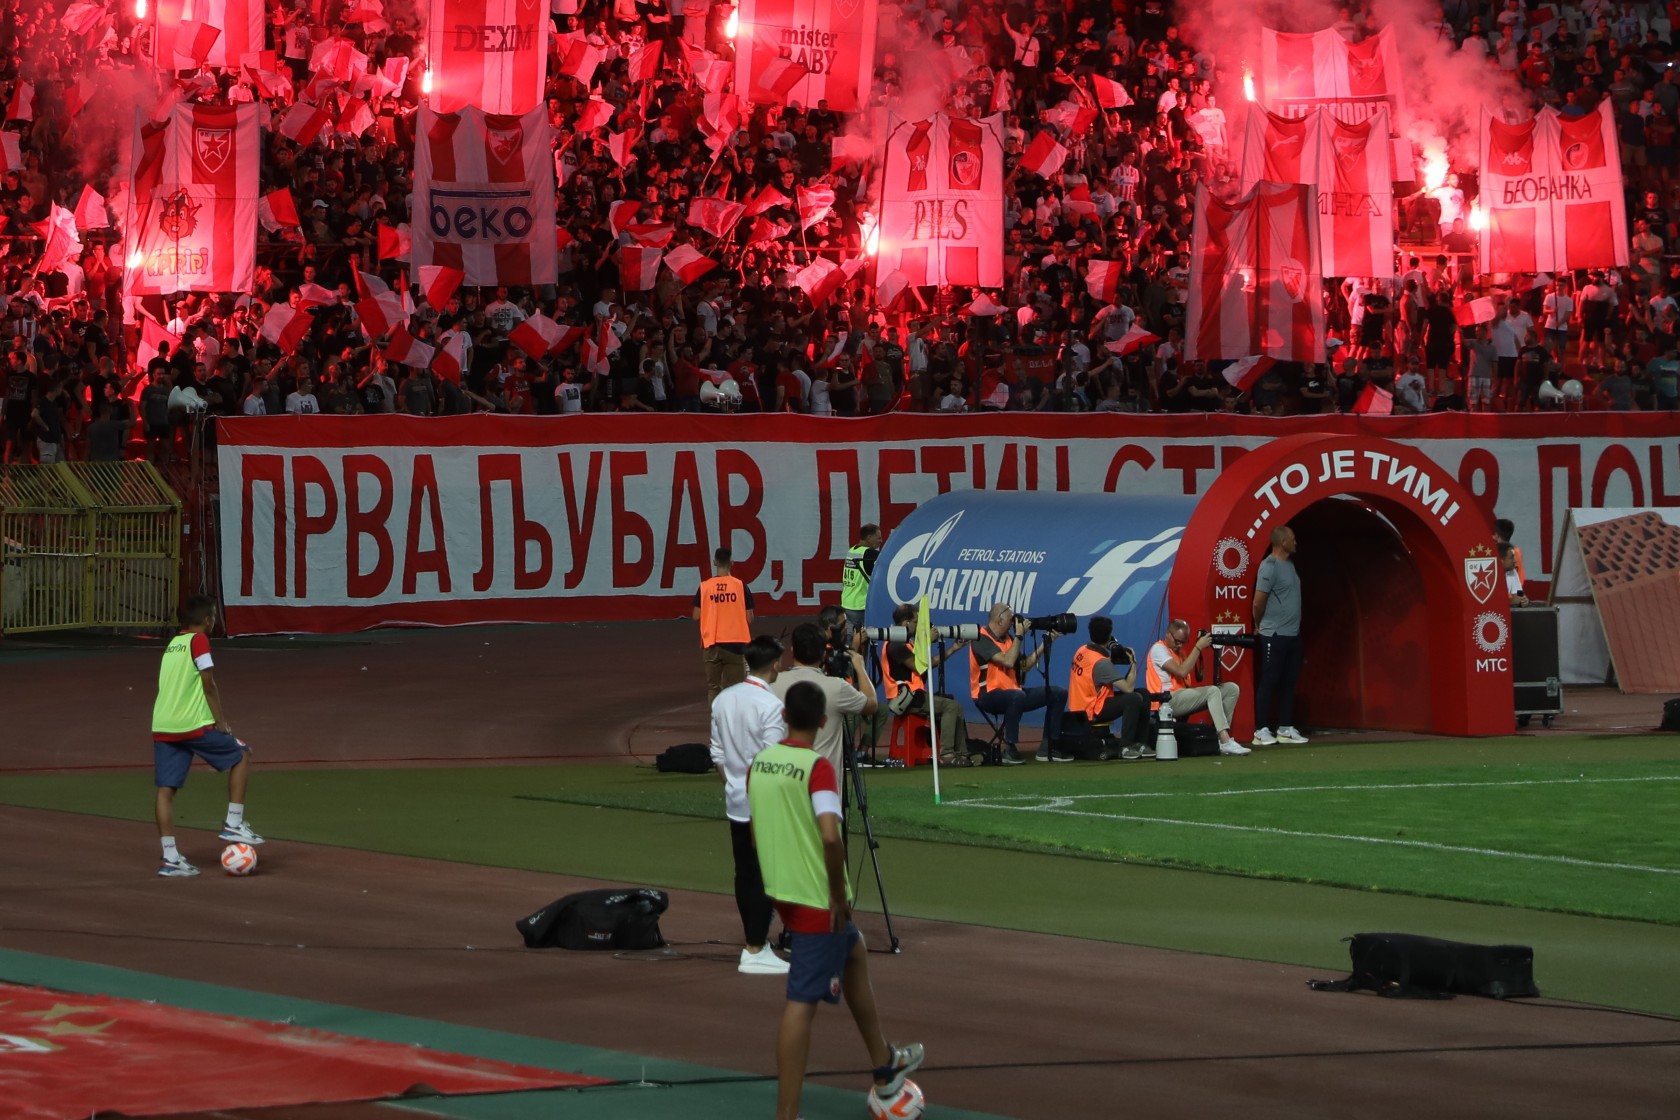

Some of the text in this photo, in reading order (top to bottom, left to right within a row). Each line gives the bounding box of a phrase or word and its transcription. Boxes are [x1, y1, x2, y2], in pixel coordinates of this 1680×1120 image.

[453, 24, 533, 53] DEXIM
[780, 24, 838, 48] mister
[1503, 175, 1592, 205] БЕОБАНКА
[430, 189, 533, 240] beko
[912, 199, 968, 241] PILS
[1363, 450, 1461, 527] ТИМ!
[240, 448, 785, 599] ПРВА ЉУБАВ,
[958, 548, 1047, 564] PETROL STATIONS
[716, 583, 728, 592] 227
[927, 568, 1038, 615] GAZPROM
